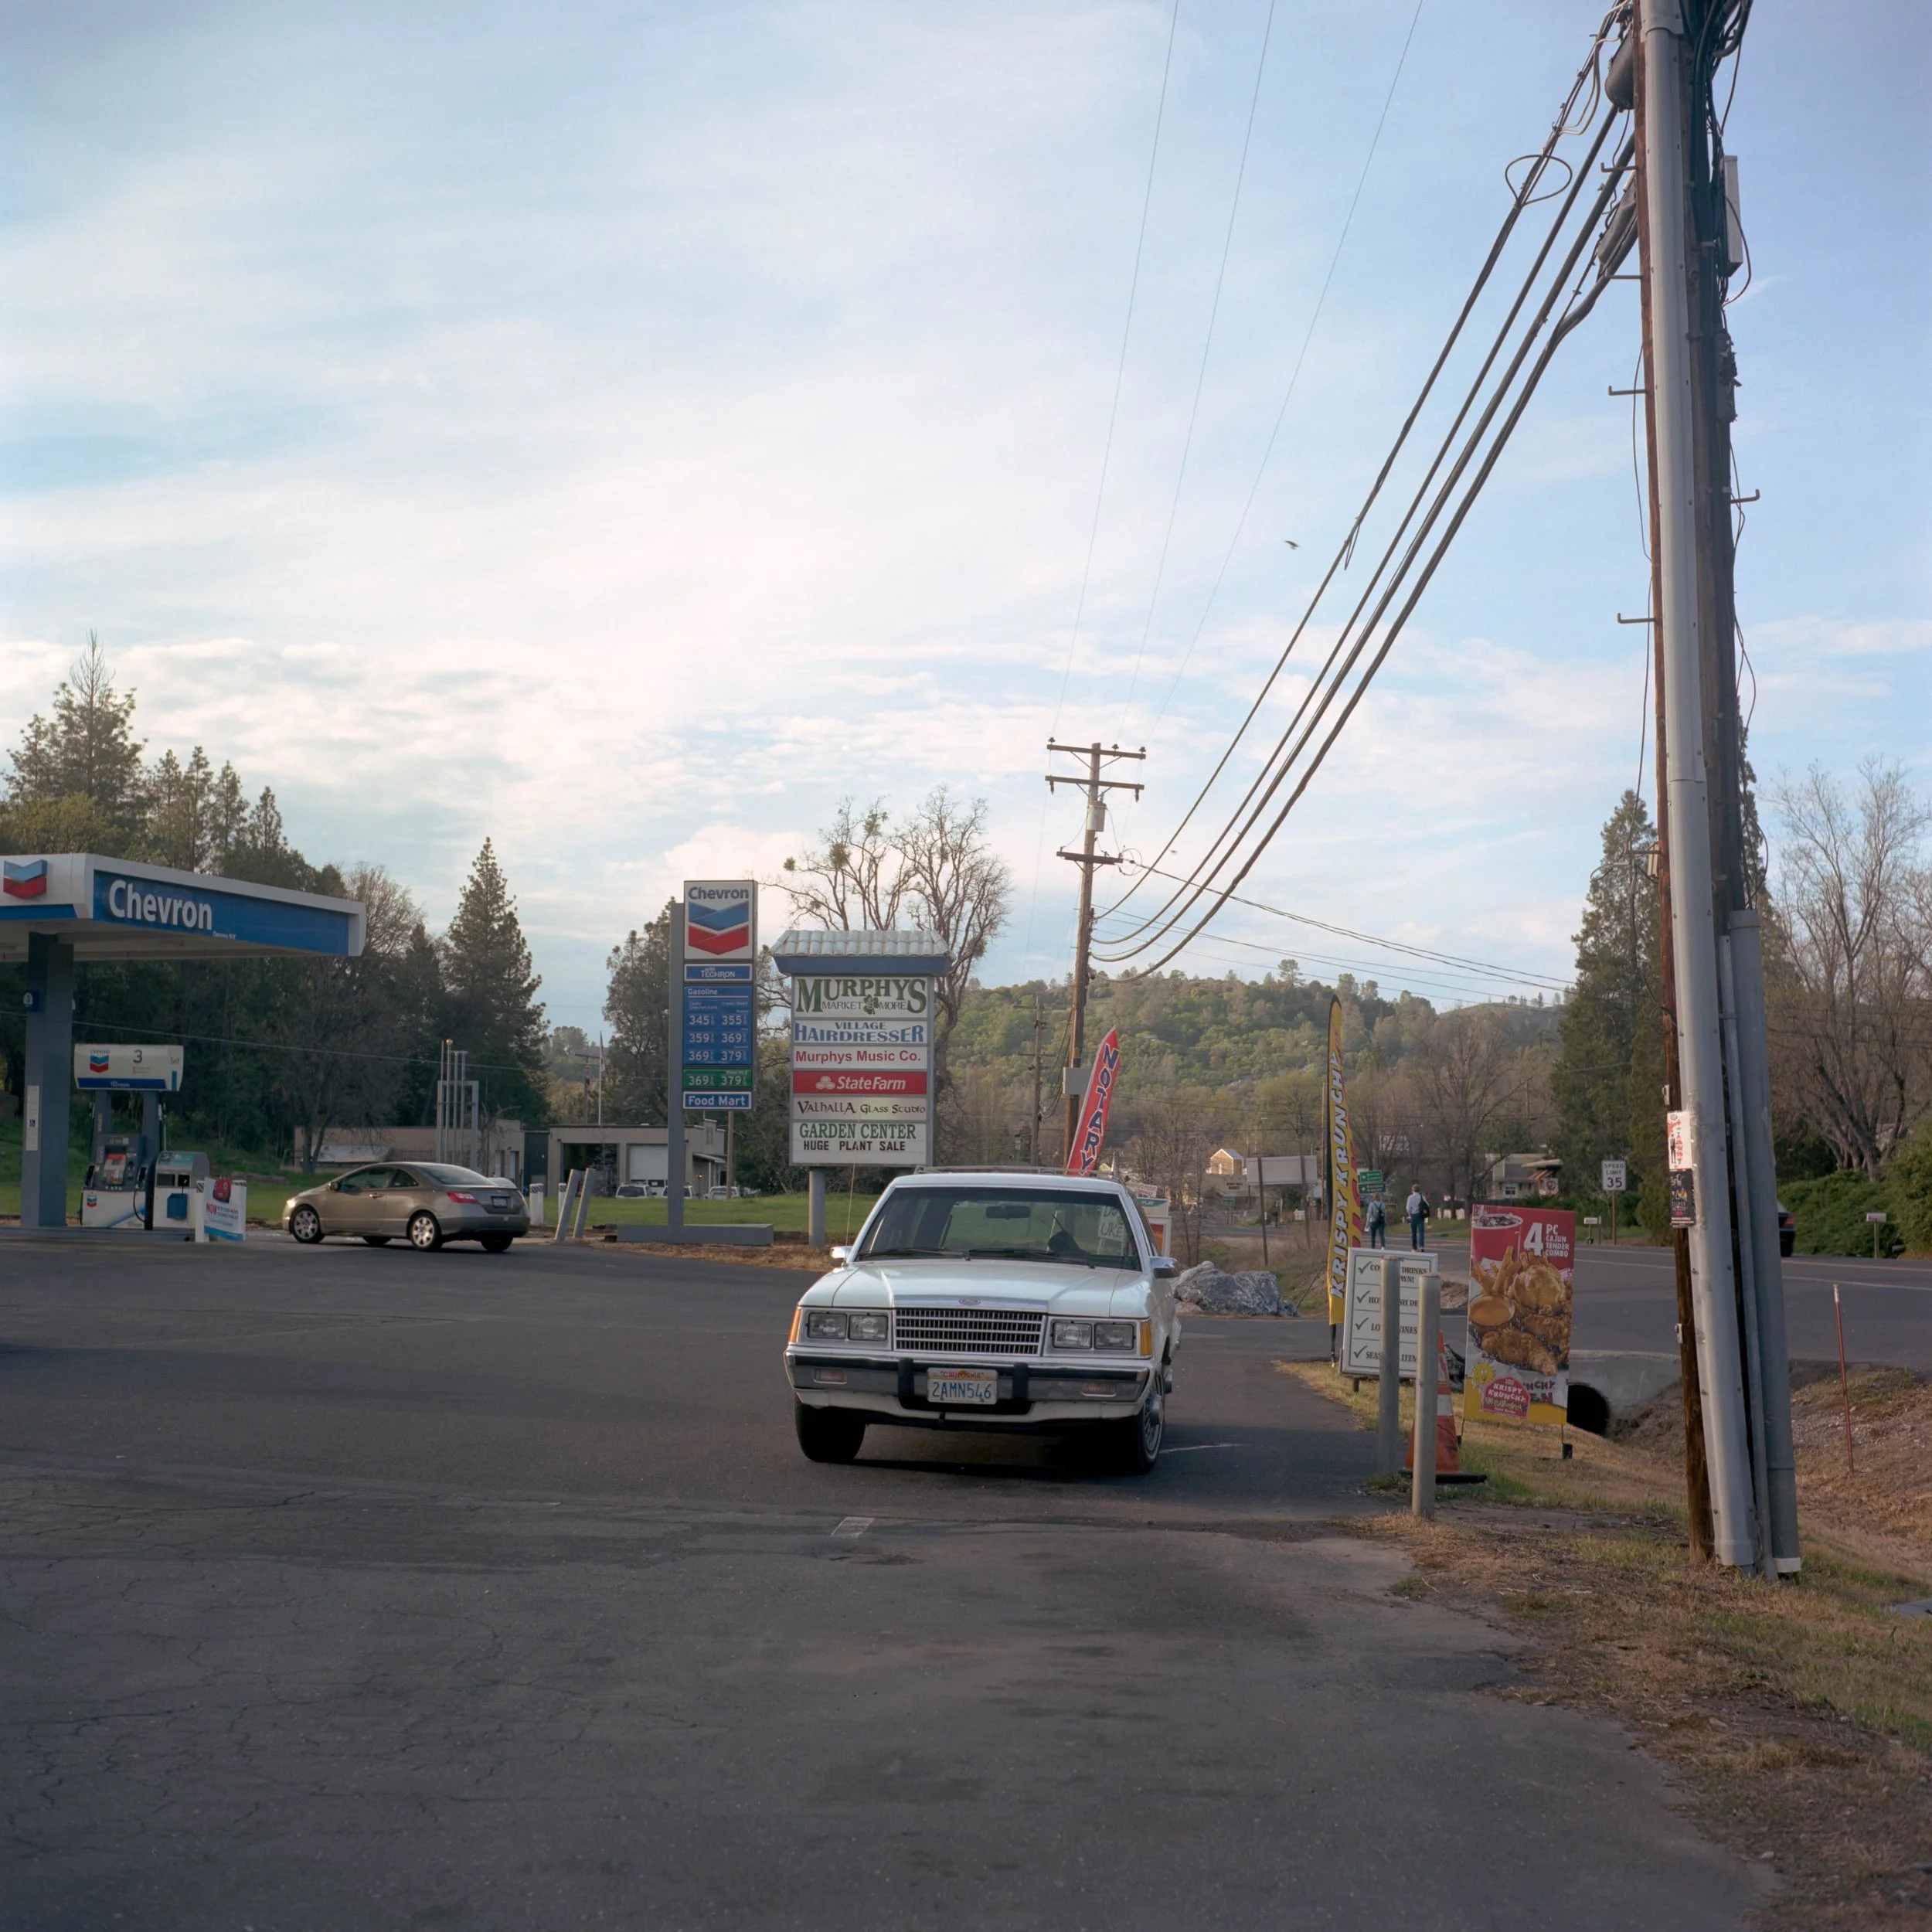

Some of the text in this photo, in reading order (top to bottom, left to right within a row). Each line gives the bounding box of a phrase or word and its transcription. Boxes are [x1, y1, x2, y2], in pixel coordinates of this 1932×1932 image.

[688, 886, 749, 900] Chevron
[109, 879, 213, 930] Chevron
[701, 970, 736, 979] TECHRON
[795, 978, 927, 1013] MURPHYS
[821, 1001, 862, 1010] MARKET
[879, 1001, 908, 1010] MORE
[689, 1015, 709, 1026] 345
[722, 1015, 742, 1026] 355
[835, 1022, 888, 1030] VILLAGE
[689, 1032, 709, 1043] 359
[722, 1032, 742, 1043] 369
[794, 1022, 924, 1043] HAIRDRESSER
[133, 1049, 143, 1063] 3
[689, 1050, 709, 1061] 369
[721, 1050, 742, 1061] 379
[795, 1050, 921, 1064] Murphys Music Co.
[689, 1075, 709, 1086] 369
[721, 1075, 742, 1086] 379
[688, 1095, 746, 1106] Food Mart
[1080, 1043, 1121, 1175] NOTARY
[799, 1123, 917, 1139] GARDEN CENTER
[804, 1141, 905, 1151] HUGE PLANT SALE
[1329, 1051, 1349, 1298] KRISPY KRUNCHY
[1607, 1177, 1622, 1188] 35
[1546, 1224, 1559, 1235] PC
[1523, 1223, 1543, 1257] 4
[932, 1382, 992, 1399] 2AMN546
[1493, 1383, 1523, 1394] KRISPY
[1488, 1389, 1526, 1402] KRUNCHY
